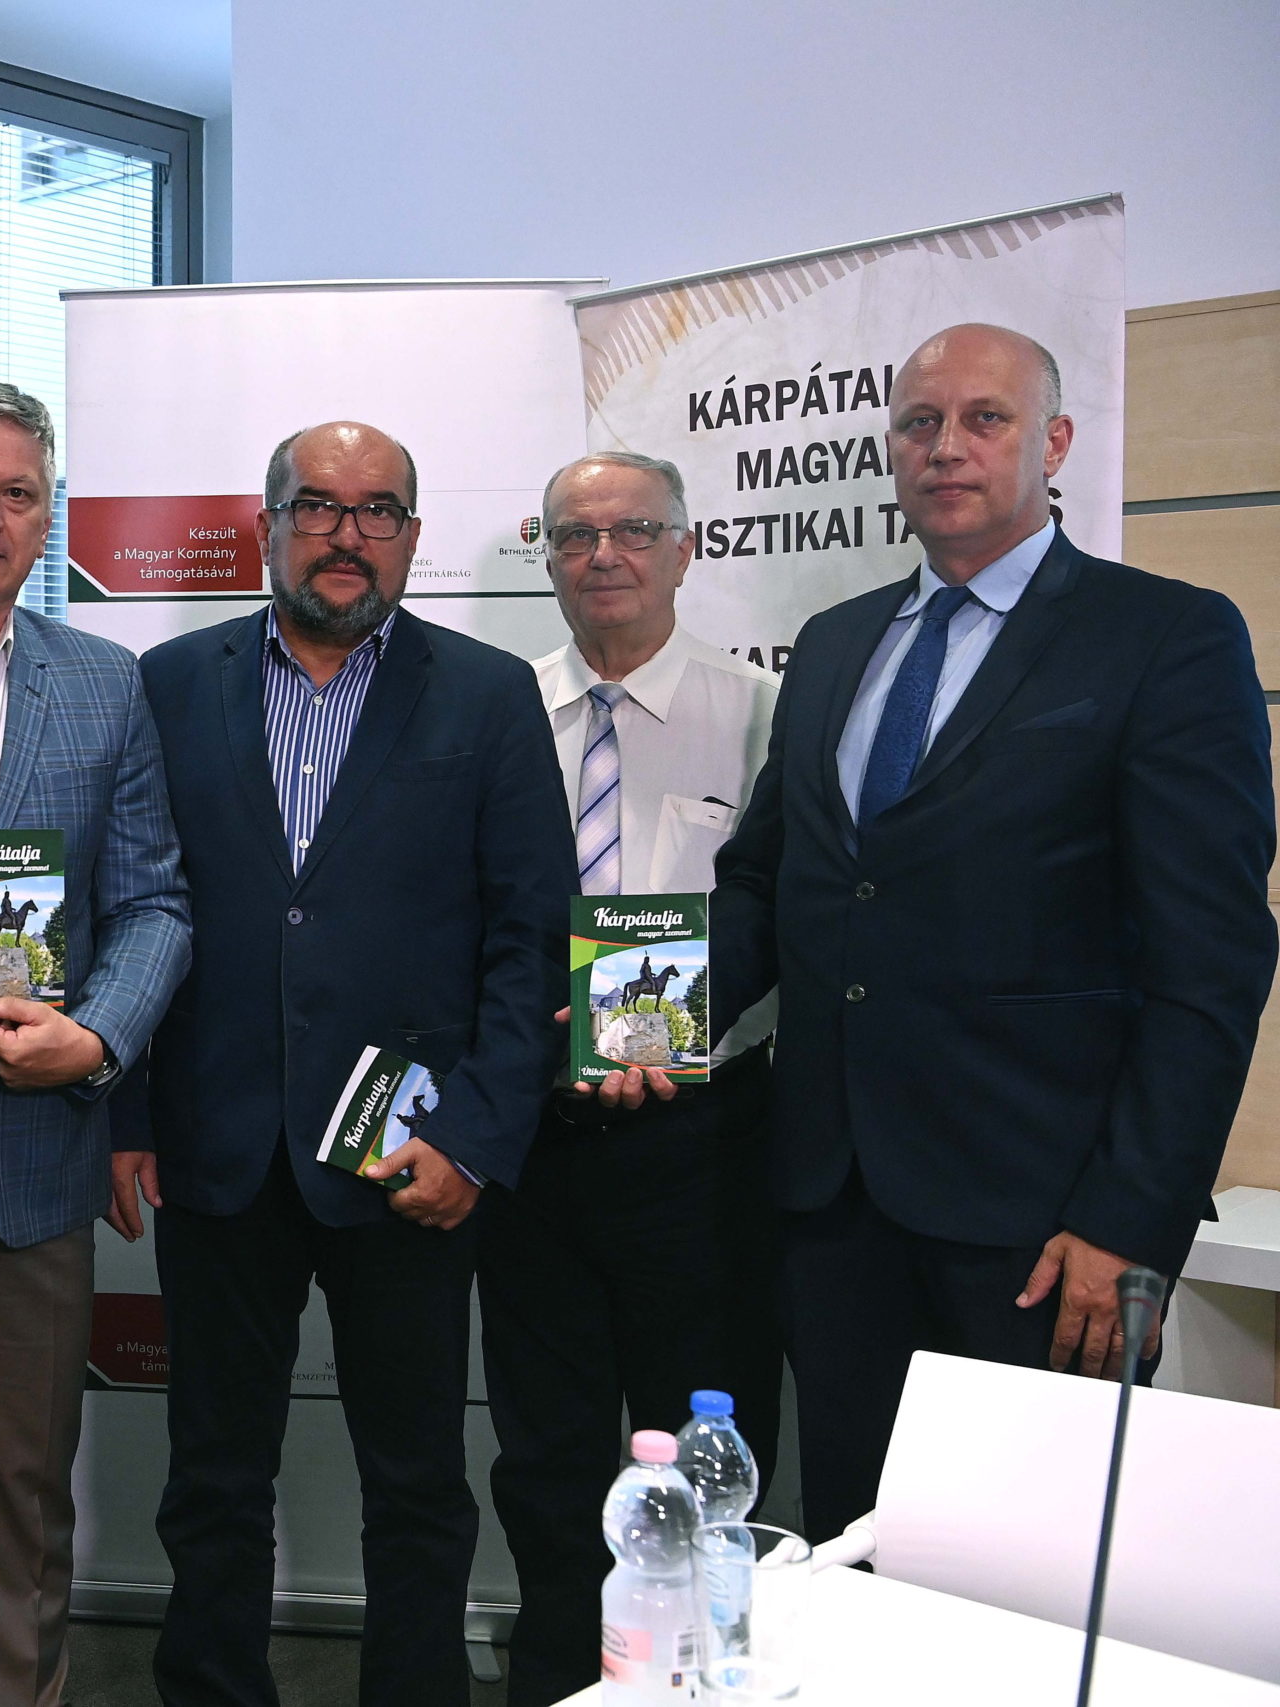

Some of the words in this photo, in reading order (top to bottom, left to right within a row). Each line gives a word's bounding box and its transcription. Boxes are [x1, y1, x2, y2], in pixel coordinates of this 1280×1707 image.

[736, 436, 894, 491] MAGYA
[189, 527, 237, 539] Készült
[114, 551, 121, 560] a
[125, 548, 174, 562] Magyar
[177, 546, 236, 561] Kormány
[499, 547, 532, 555] BETHLEN
[140, 565, 236, 581] támogatásával
[408, 569, 471, 579] MTITKÁRSÁG
[594, 908, 683, 931] Kárpátalja
[637, 930, 664, 939] magyar
[581, 1065, 612, 1076] Útikön
[344, 1073, 389, 1149] Kárpátalja
[116, 1343, 123, 1352] a
